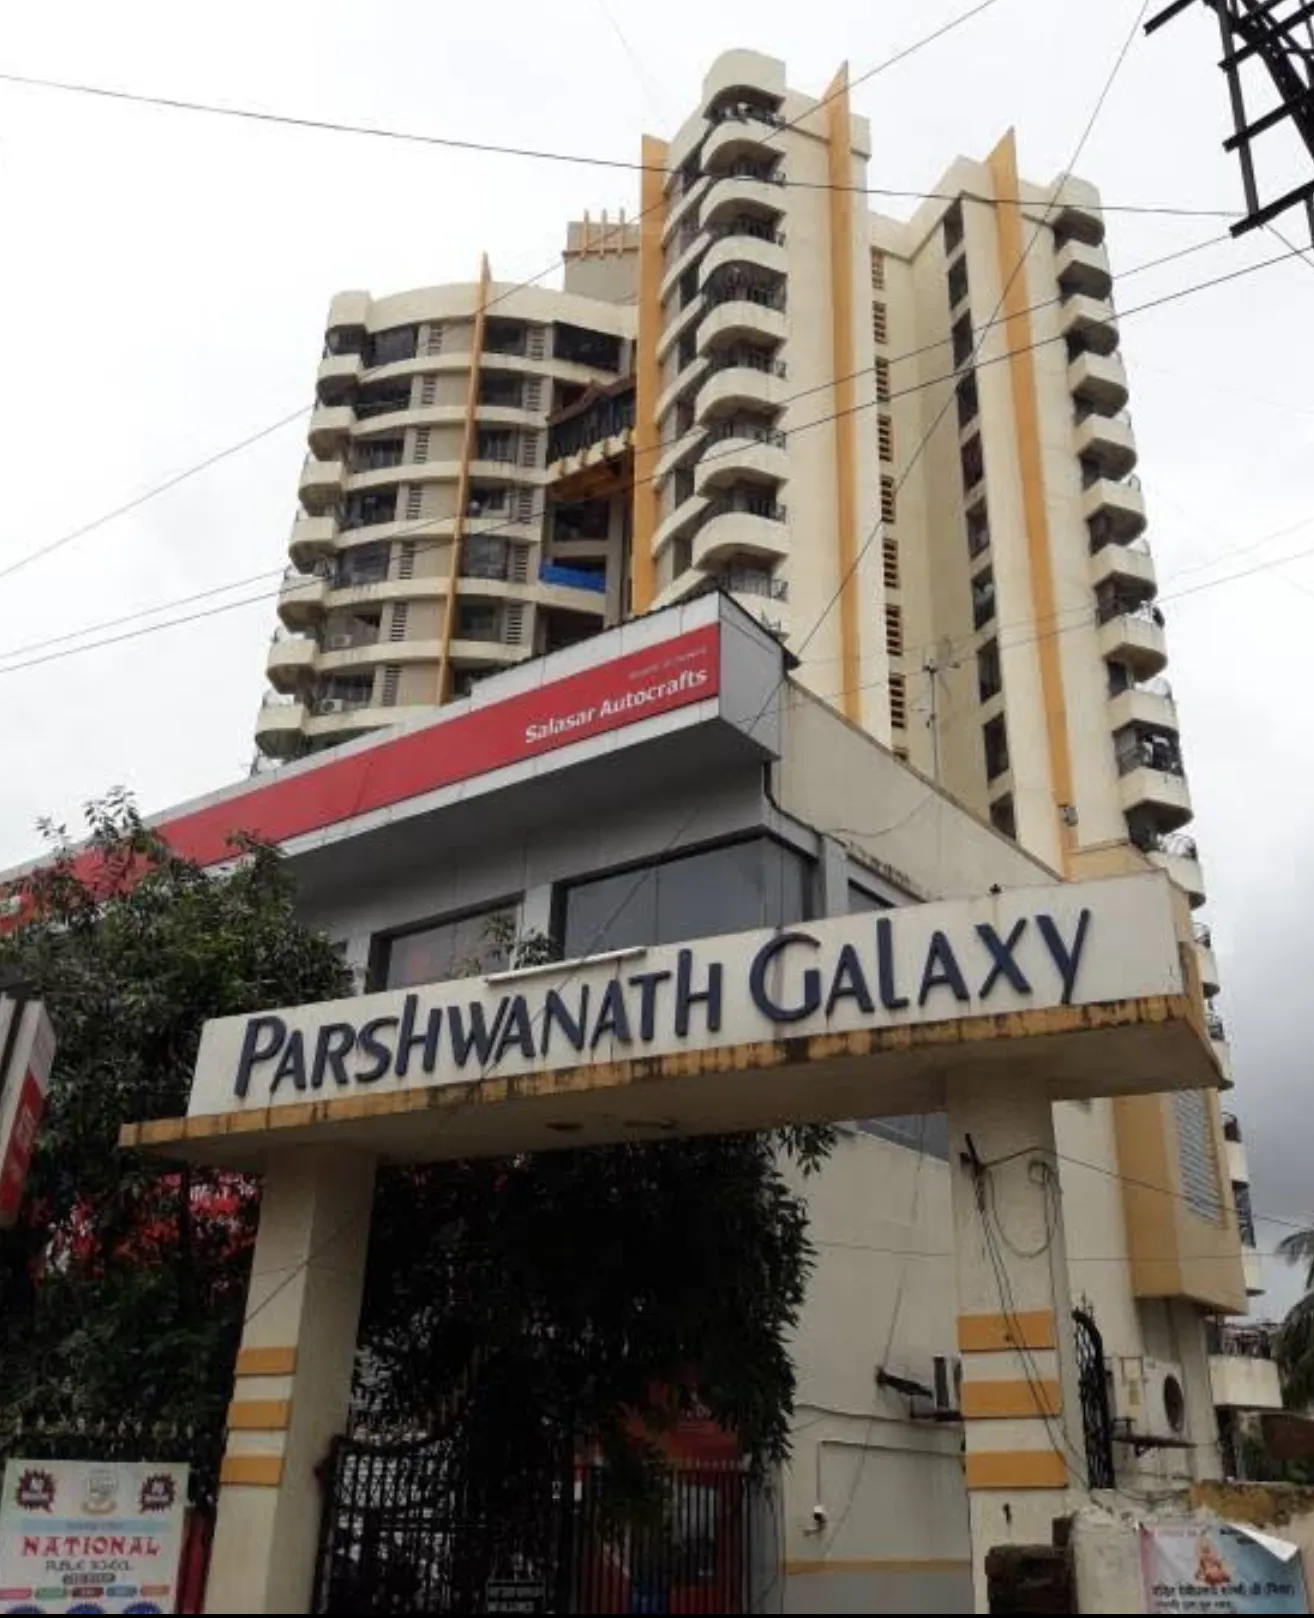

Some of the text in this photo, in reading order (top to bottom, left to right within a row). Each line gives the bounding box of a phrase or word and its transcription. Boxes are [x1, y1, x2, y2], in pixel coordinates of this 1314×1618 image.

[525, 667, 708, 744] Salasar Autocrafts
[234, 908, 1091, 1098] PARSHWANATH GALAXY
[22, 1535, 161, 1557] NATIONAL
